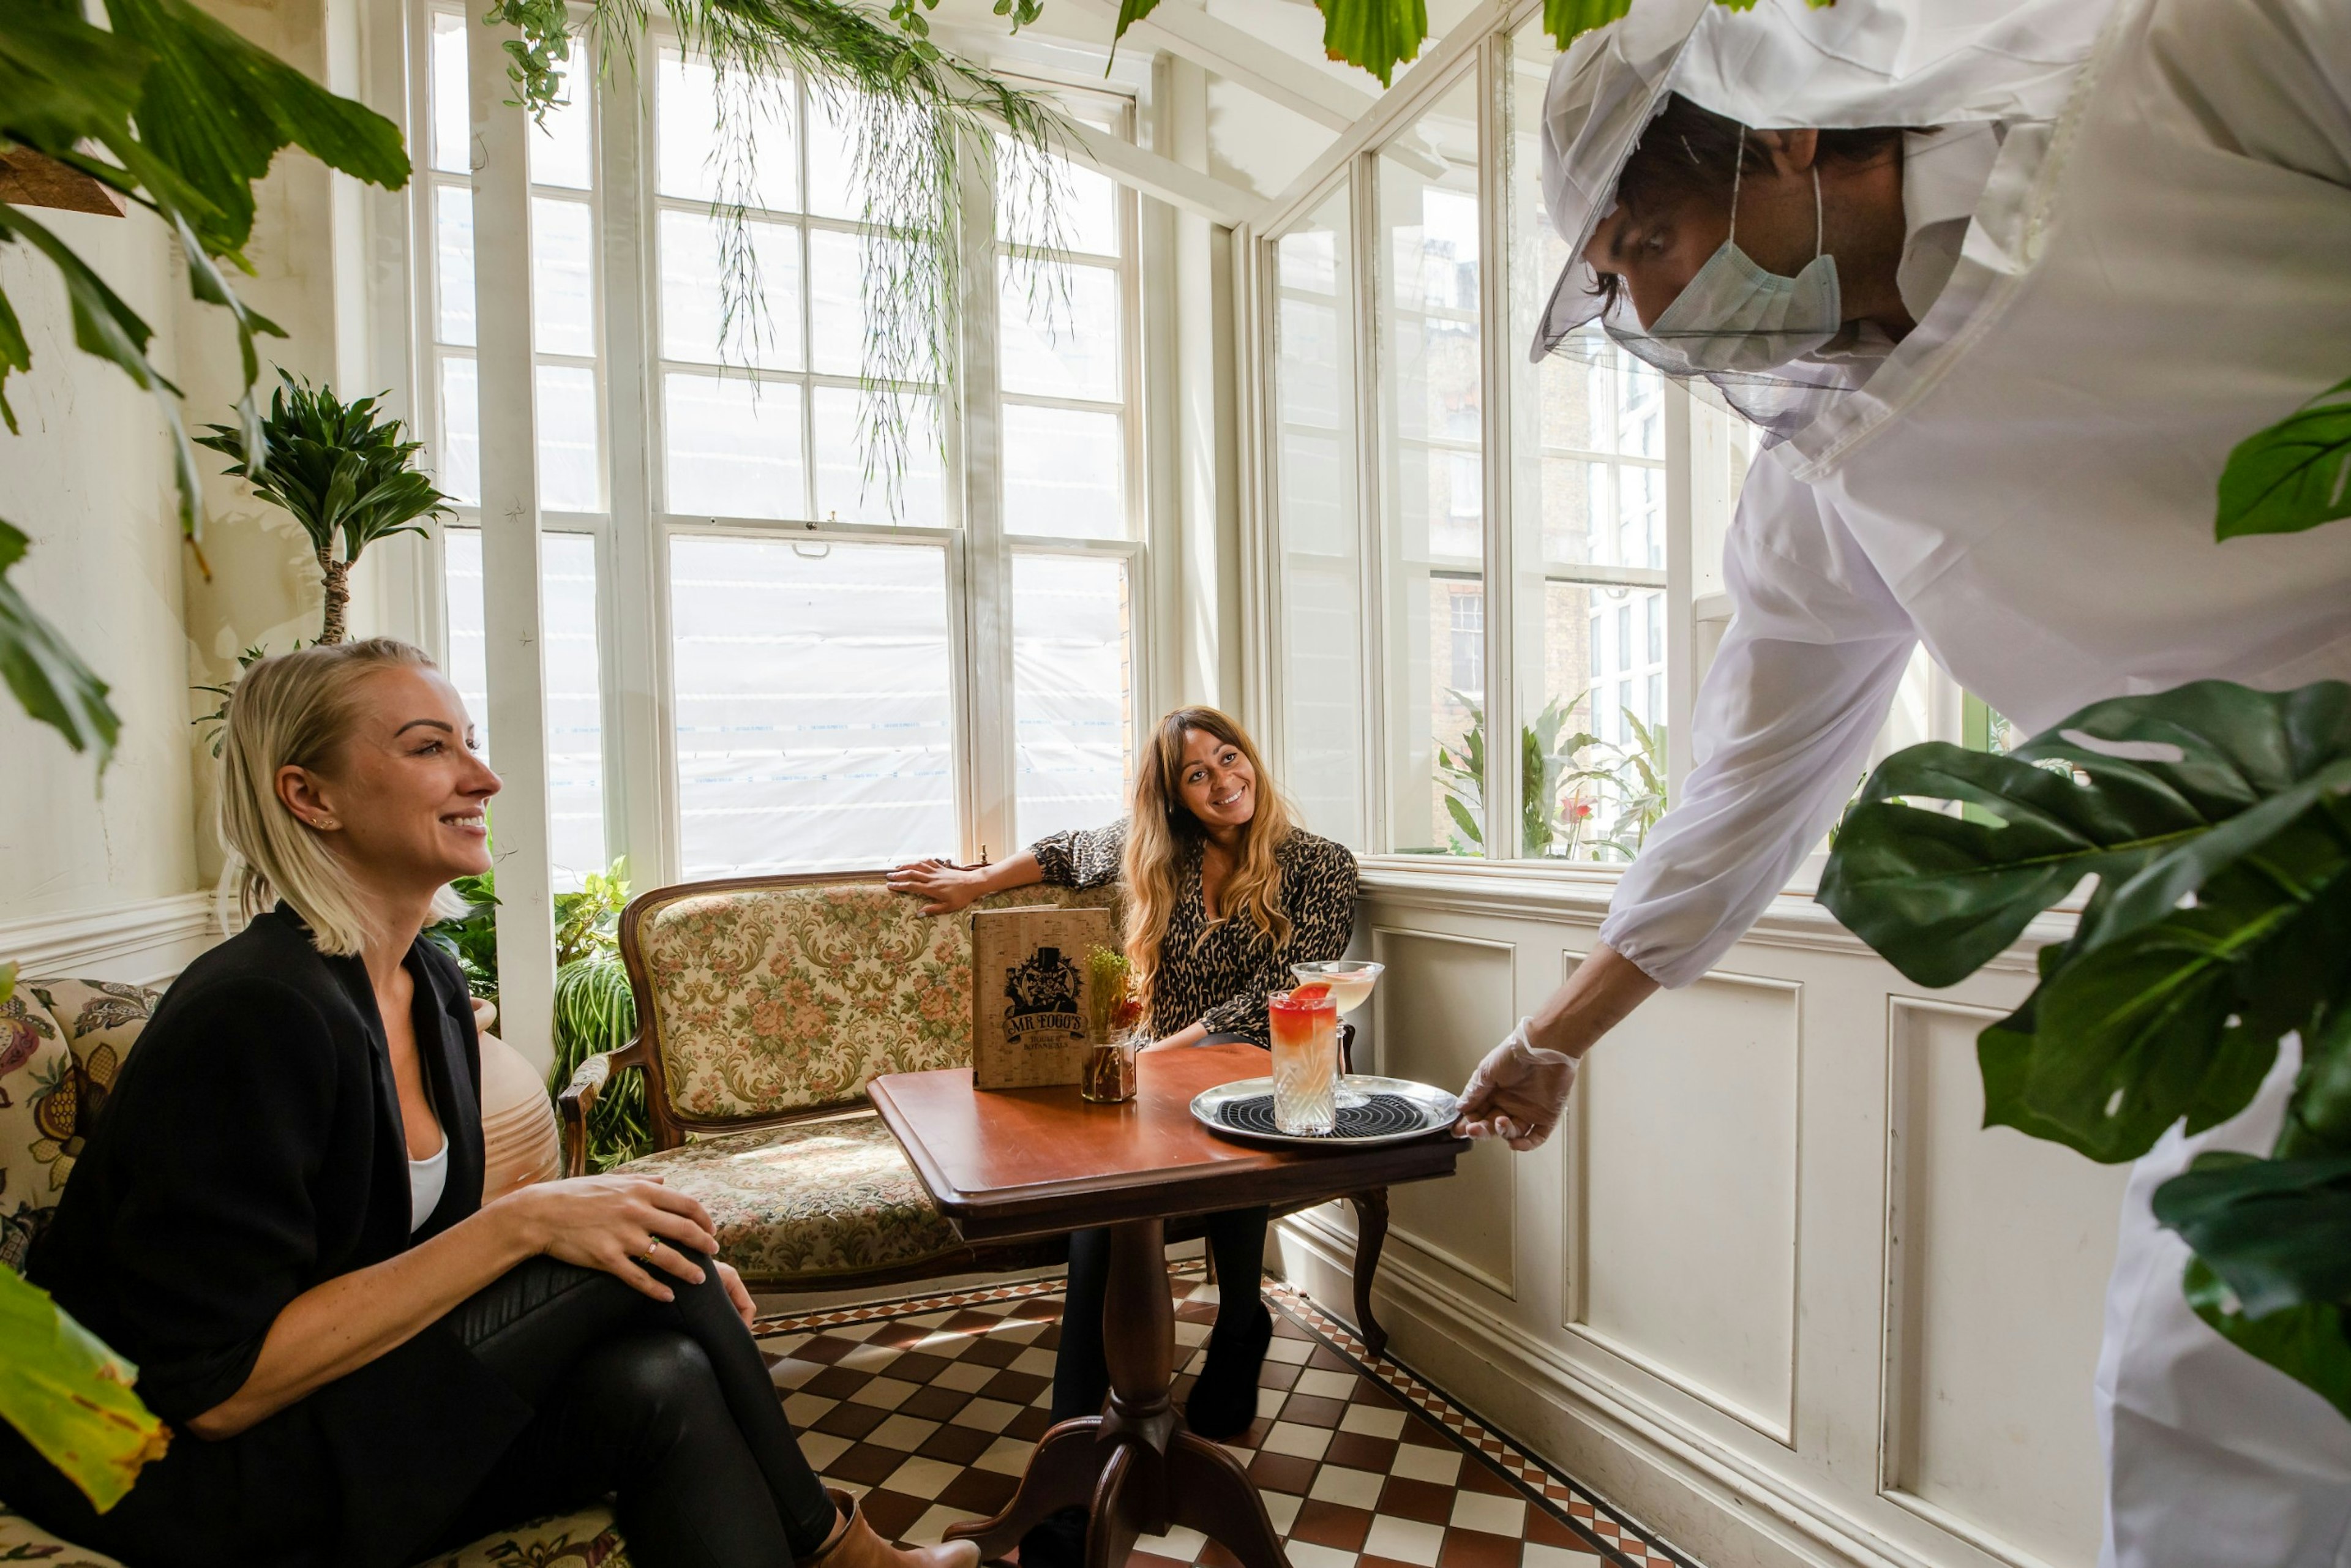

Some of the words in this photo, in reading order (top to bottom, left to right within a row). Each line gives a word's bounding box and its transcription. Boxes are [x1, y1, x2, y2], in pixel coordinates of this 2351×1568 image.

[1008, 1016, 1034, 1035] MR
[1037, 1014, 1081, 1030] FOGG'S
[1024, 1042, 1068, 1051] BOTANICALS
